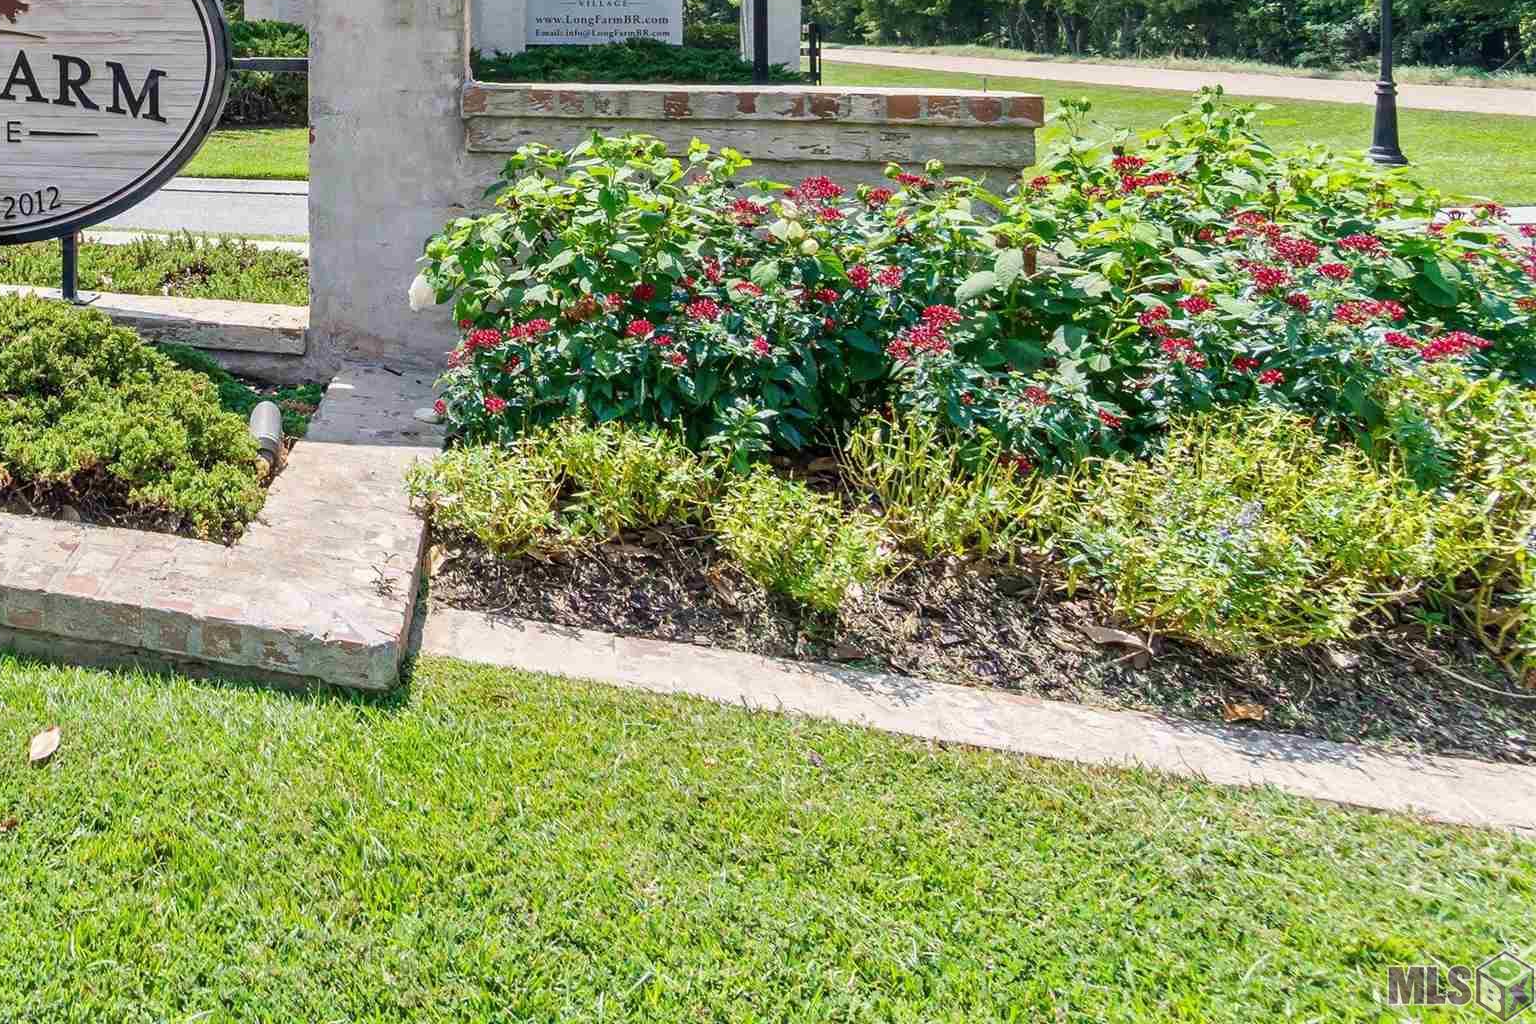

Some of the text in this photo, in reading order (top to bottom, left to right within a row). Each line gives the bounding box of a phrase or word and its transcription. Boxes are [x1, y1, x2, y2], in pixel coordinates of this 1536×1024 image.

[578, 0, 629, 8] VILLAGE
[535, 14, 670, 27] www.LongFarmBR.com
[2, 185, 63, 220] 2012
